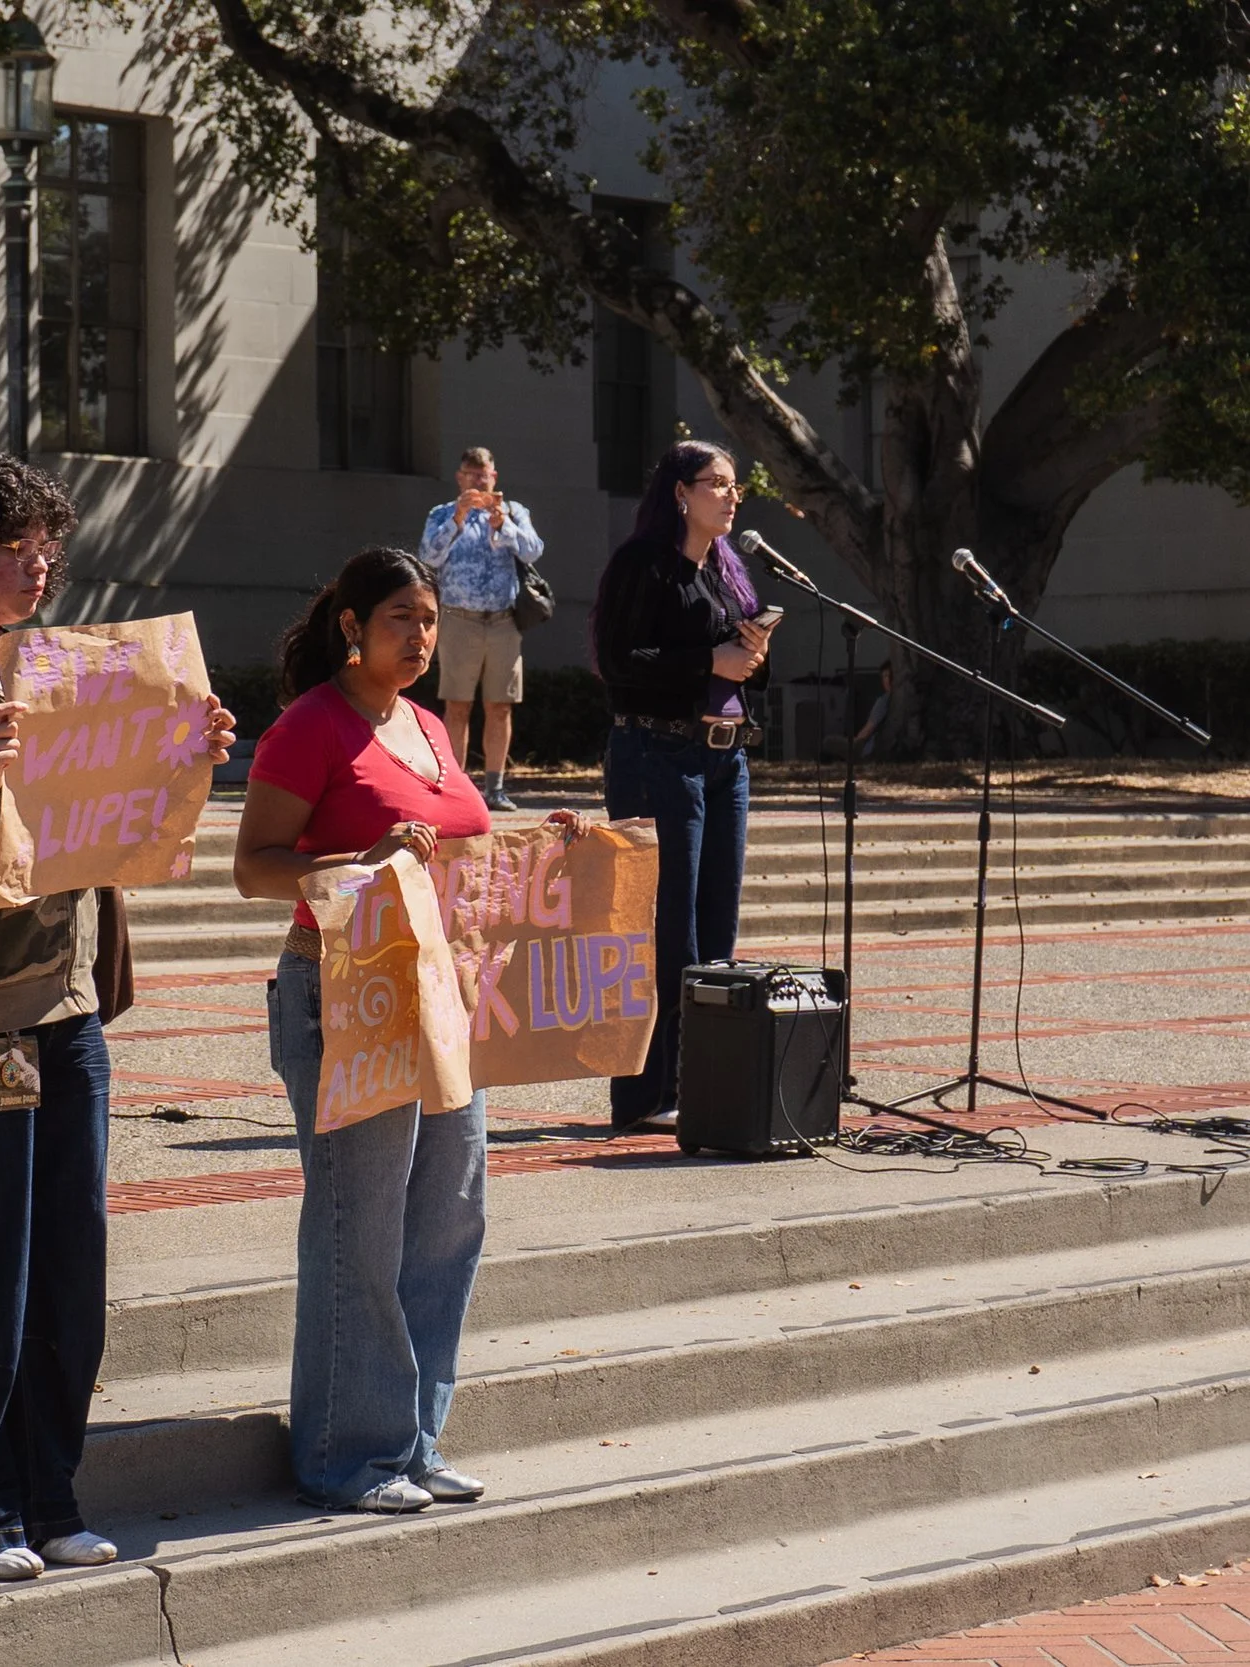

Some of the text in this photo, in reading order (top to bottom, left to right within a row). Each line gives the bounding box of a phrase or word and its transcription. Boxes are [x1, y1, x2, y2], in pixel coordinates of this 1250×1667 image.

[74, 641, 141, 705] WE
[23, 707, 164, 786] WANT
[37, 787, 168, 862] LUPE!
[528, 931, 648, 1032] LUPE
